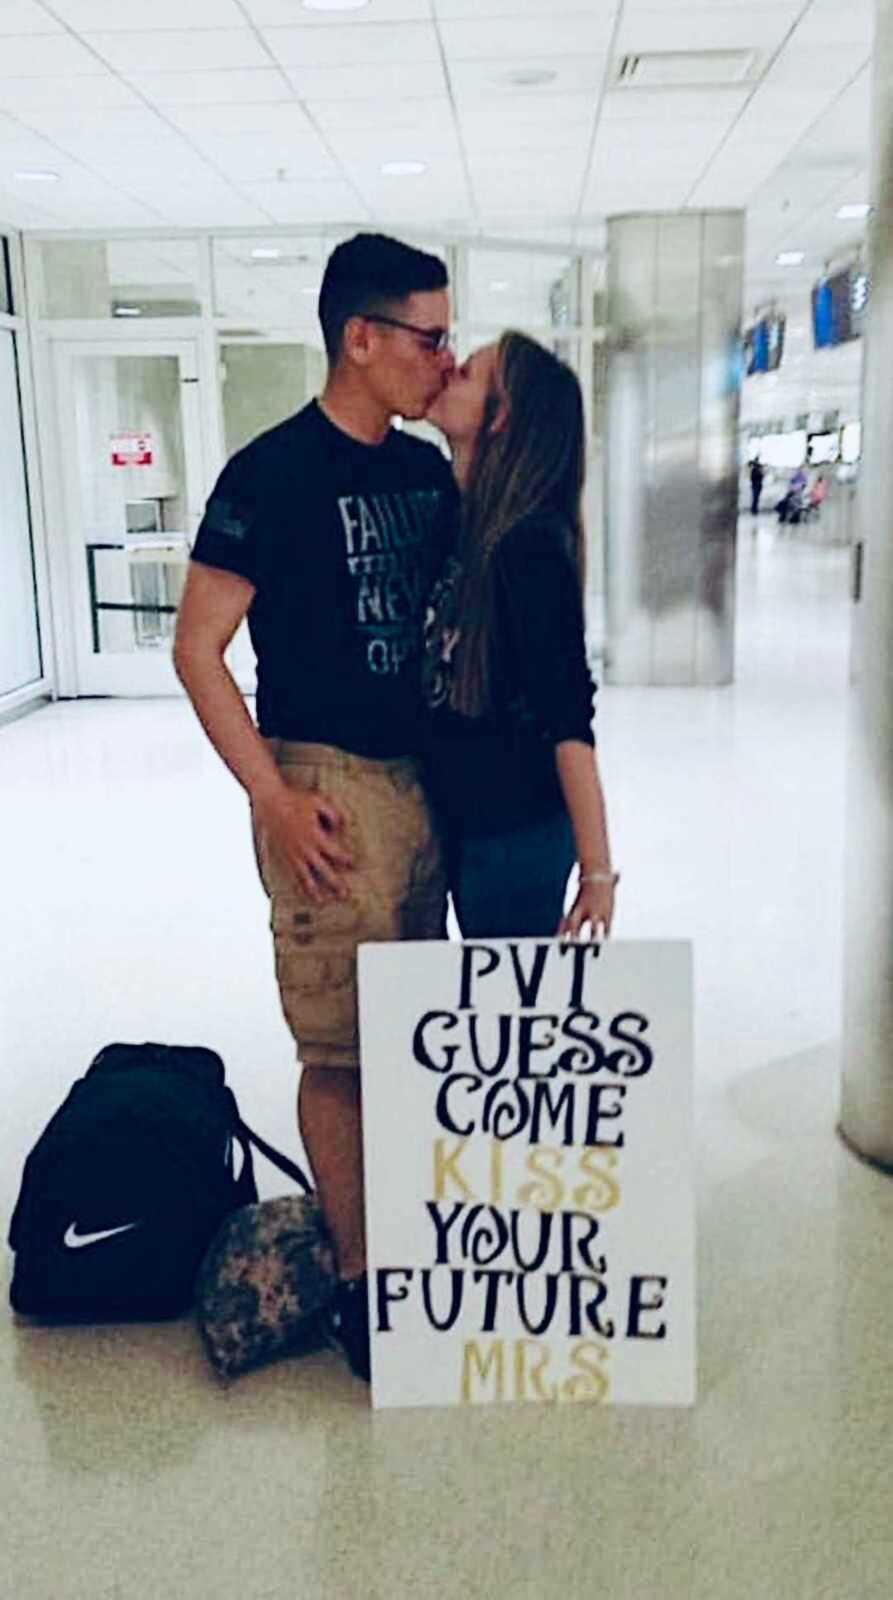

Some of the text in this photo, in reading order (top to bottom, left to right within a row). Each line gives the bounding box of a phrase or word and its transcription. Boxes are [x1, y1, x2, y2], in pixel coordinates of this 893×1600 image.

[337, 489, 440, 554] FAILU
[357, 575, 422, 624] NEV
[458, 943, 601, 1010] PVT
[412, 1010, 654, 1079] GUESS
[435, 1073, 627, 1147] COME
[432, 1138, 622, 1215] KISS
[425, 1201, 607, 1275] YOUR
[374, 1267, 669, 1339] FUTURE
[460, 1337, 613, 1406] MRS
